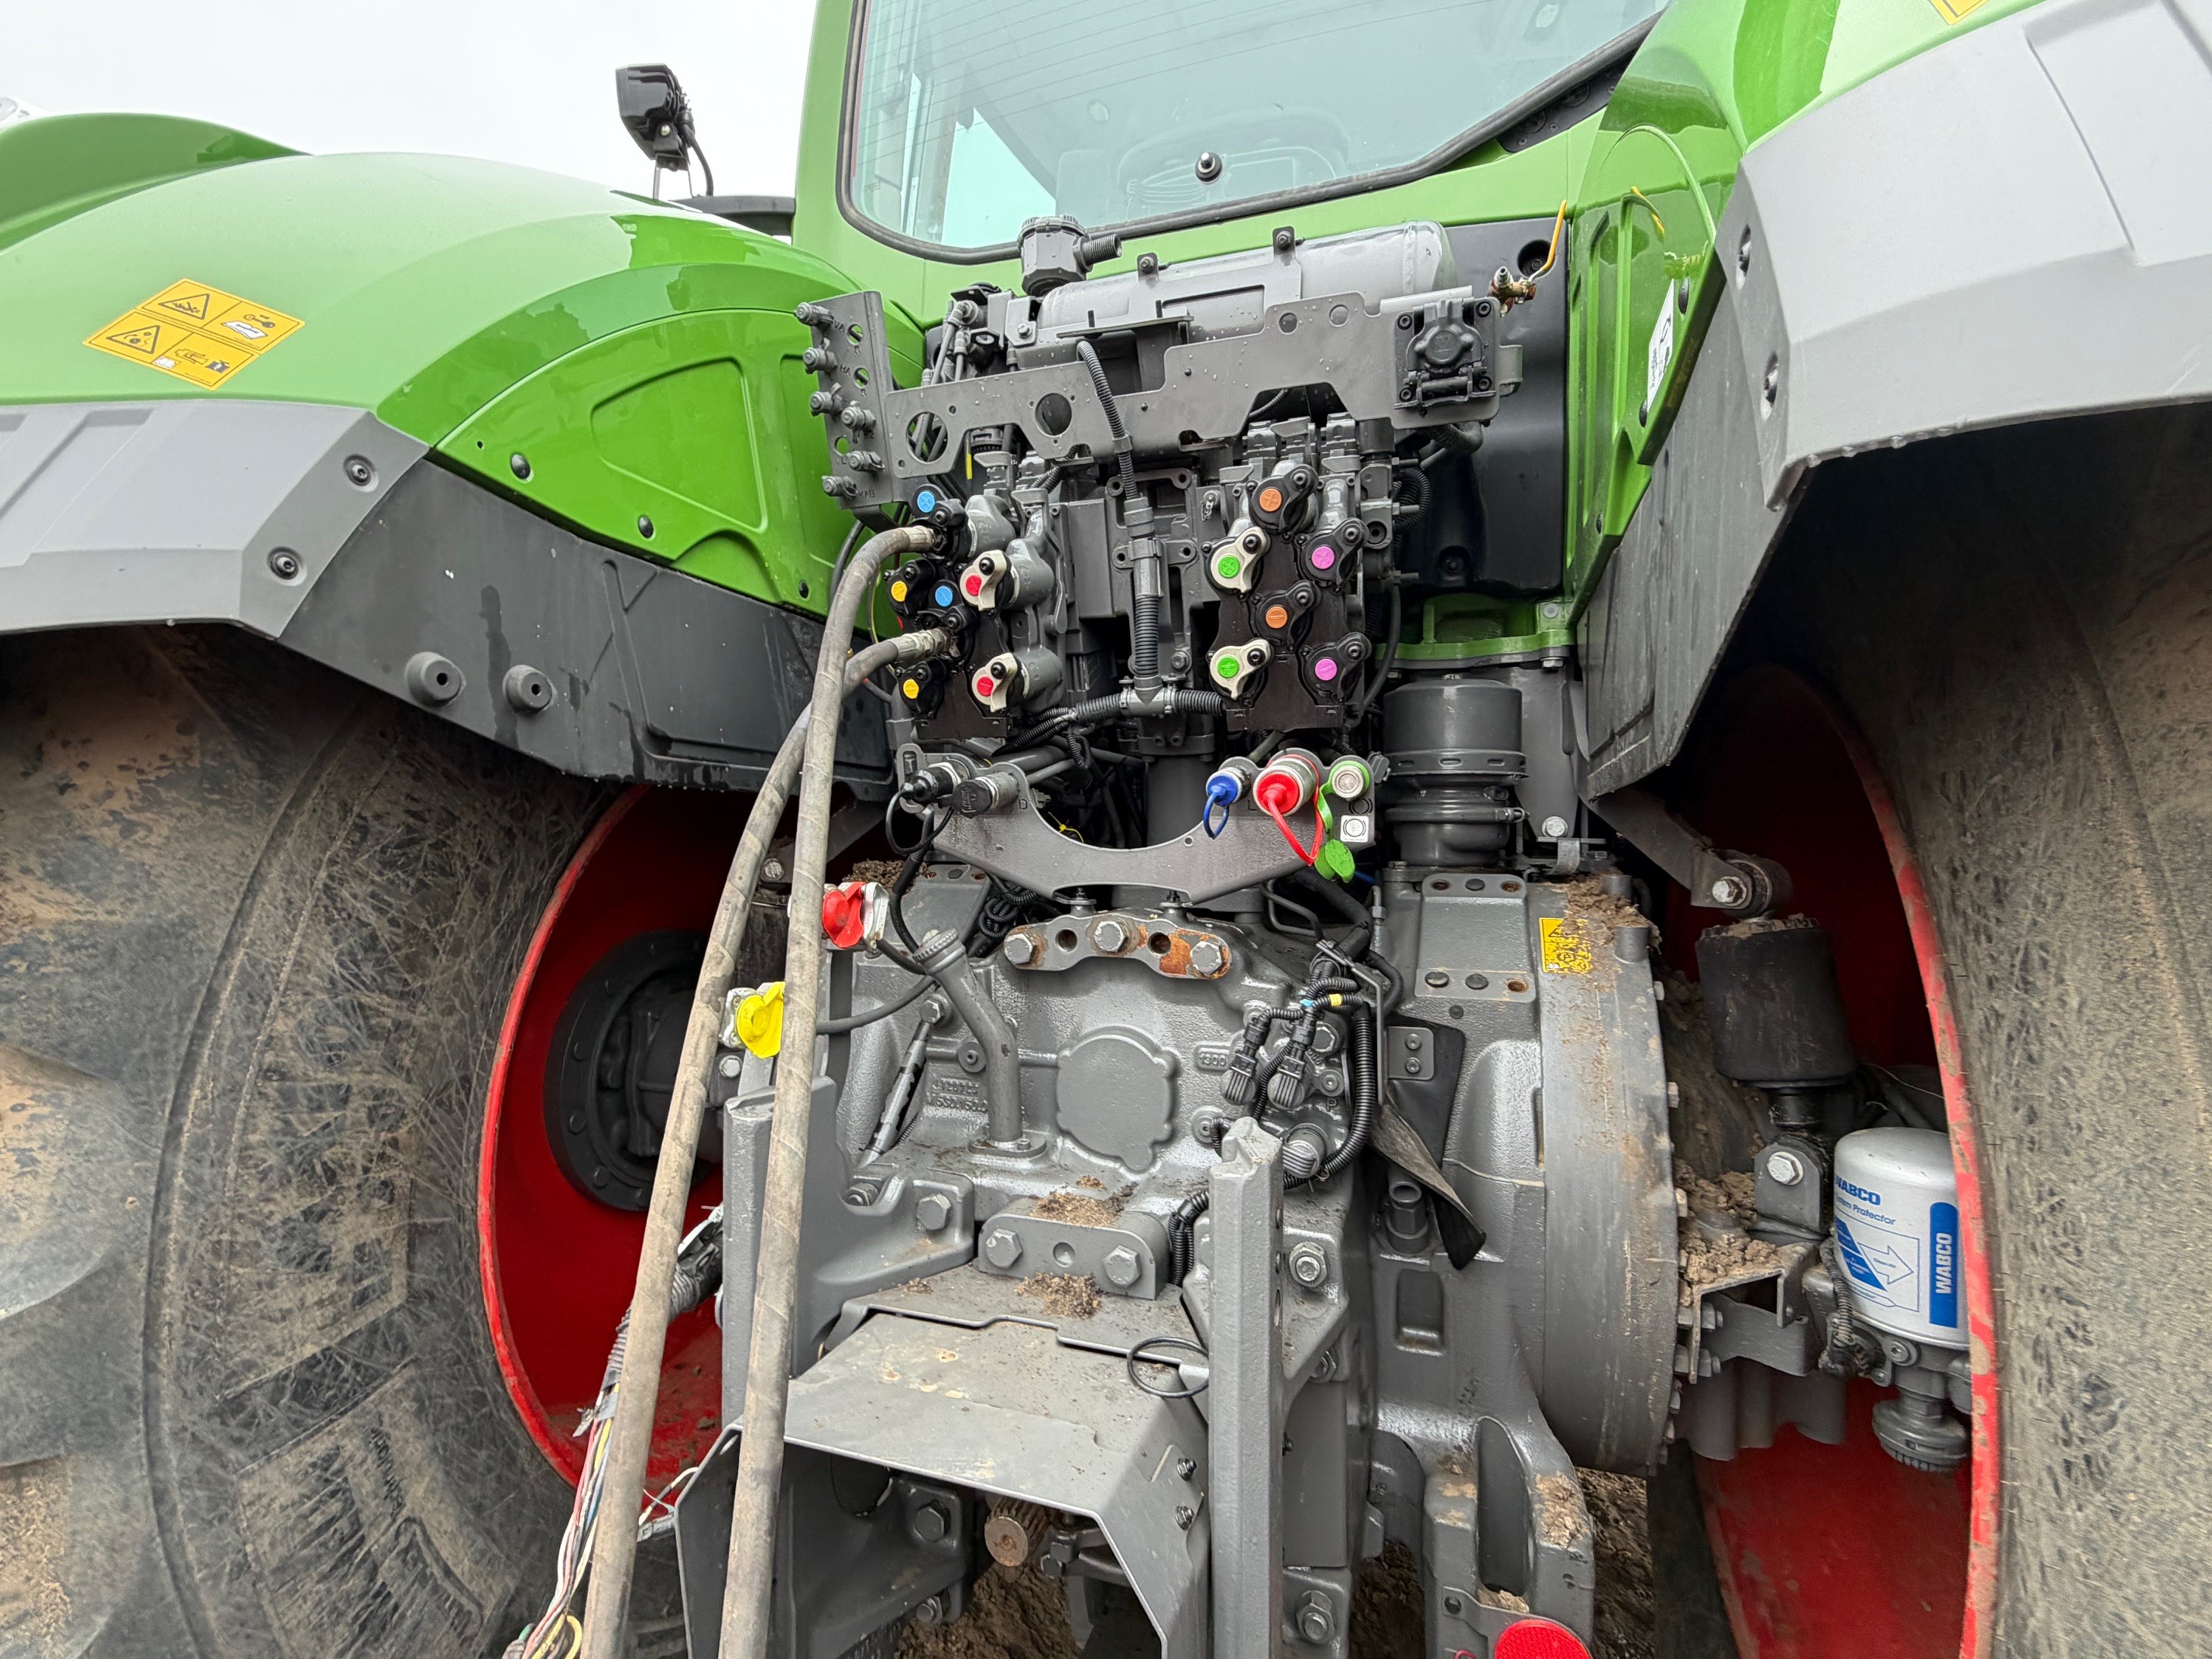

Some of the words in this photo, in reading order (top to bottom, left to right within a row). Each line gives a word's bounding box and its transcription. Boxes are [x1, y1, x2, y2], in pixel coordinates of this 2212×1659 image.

[1018, 799, 1029, 810] D
[1325, 1097, 1338, 1112] P
[1853, 1204, 1896, 1225] Protector
[1936, 1232, 1953, 1294] WABCO
